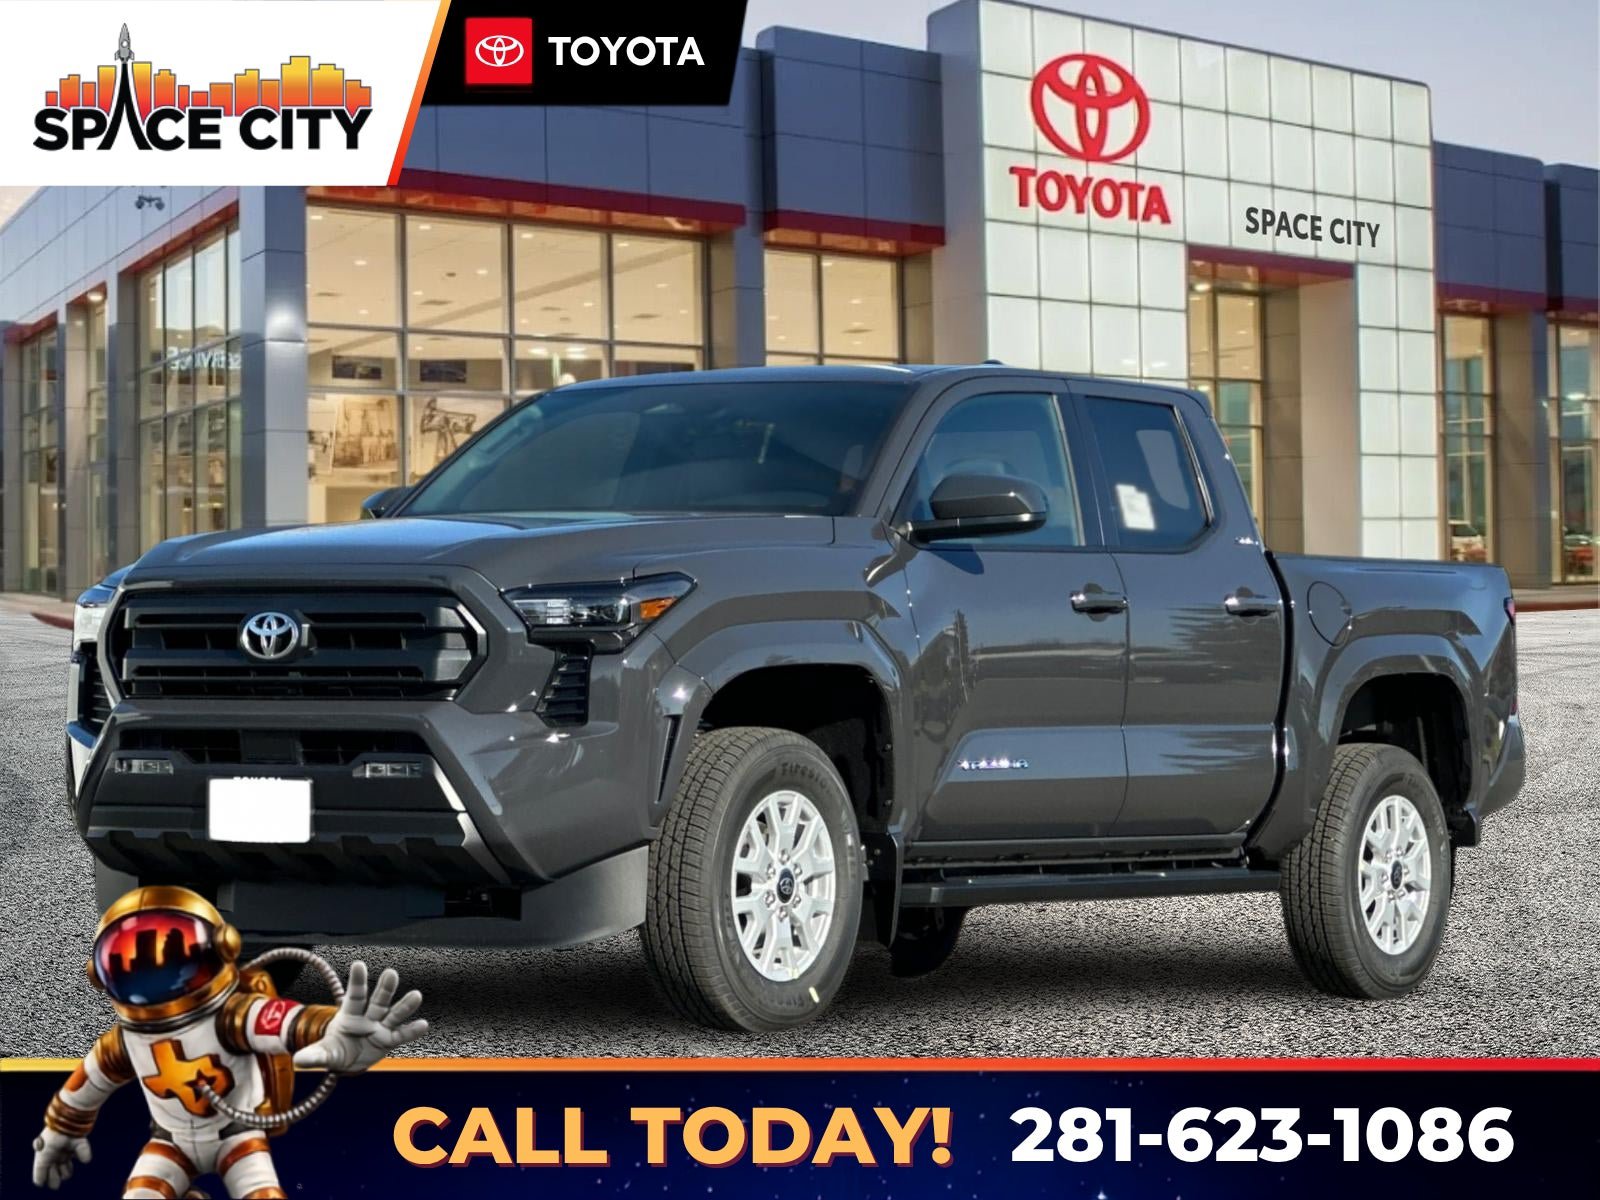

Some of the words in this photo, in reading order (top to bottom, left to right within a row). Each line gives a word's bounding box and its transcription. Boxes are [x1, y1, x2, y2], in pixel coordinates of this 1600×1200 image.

[1009, 166, 1171, 224] TOYOTA
[1245, 206, 1323, 242] SPACE
[1329, 218, 1380, 248] CITY
